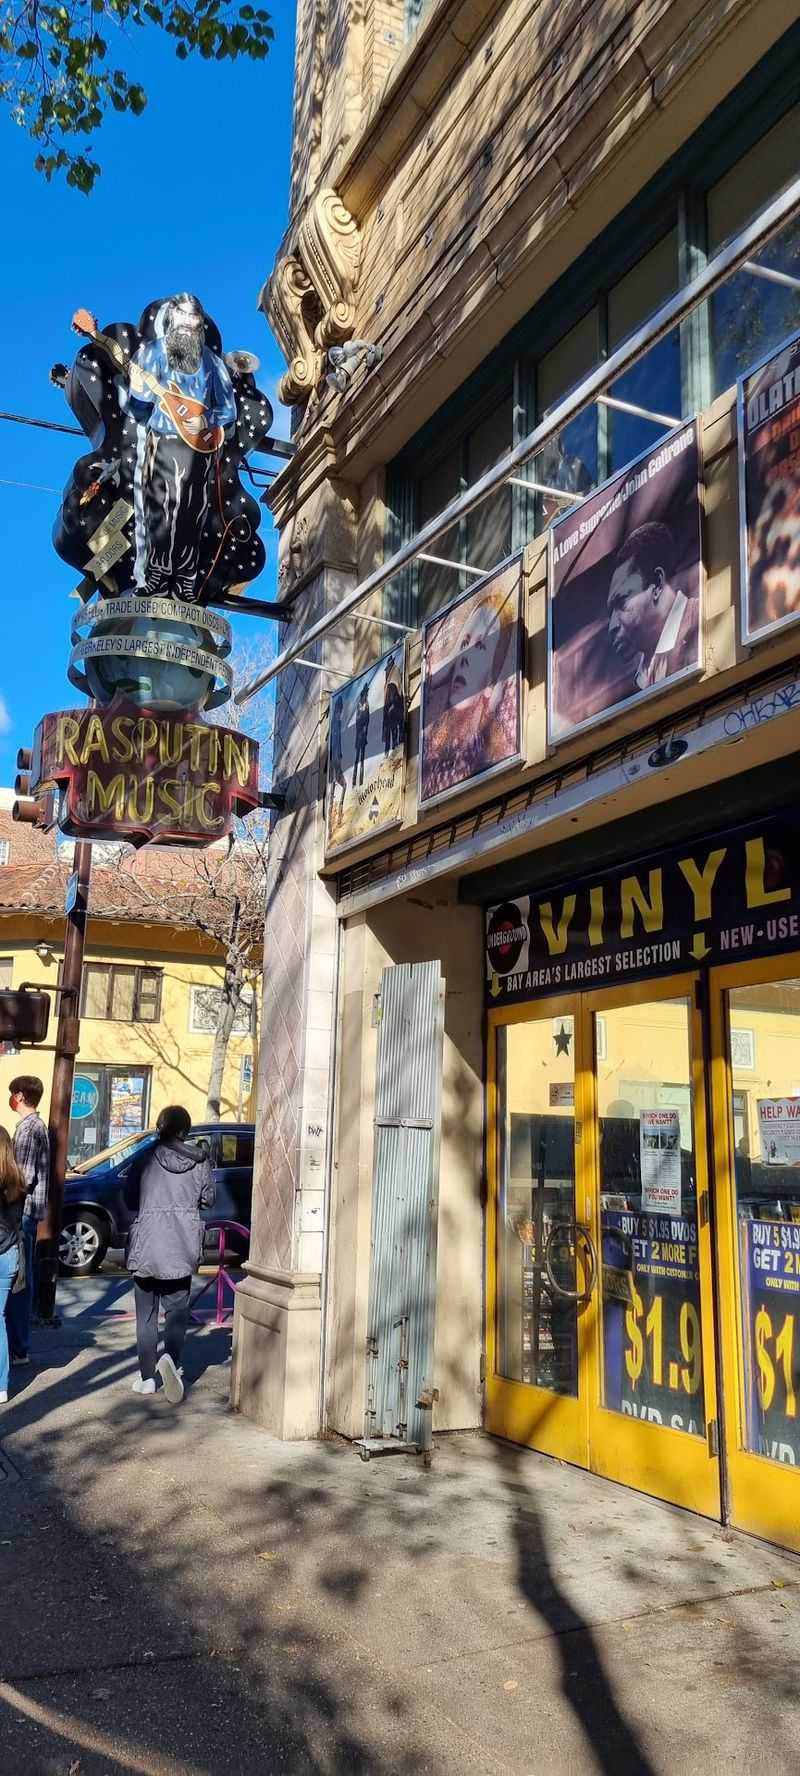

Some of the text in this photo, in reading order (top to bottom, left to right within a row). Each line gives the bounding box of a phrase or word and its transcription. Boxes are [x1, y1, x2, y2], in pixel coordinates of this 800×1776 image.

[553, 545, 560, 564] A
[560, 530, 579, 557] Love
[649, 428, 694, 478] Coltrane
[106, 601, 132, 615] TRADE
[134, 601, 158, 614] USED
[161, 602, 201, 621] COMPACT
[124, 640, 165, 655] LARGEST
[166, 643, 217, 671] INDEPENDENT
[55, 715, 250, 787] RASPUTIN
[85, 771, 225, 827] MUSIC
[538, 836, 792, 956] VINYL
[487, 925, 528, 949] UNDERGROUND
[720, 915, 800, 950] NEW USE
[507, 940, 681, 992] BAY AREA'S LARGEST SELECTION
[760, 1106, 782, 1120] HELP
[622, 1216, 697, 1242] BUY 5 $1.95 DVDS
[752, 1223, 771, 1246] BUY
[773, 1226, 780, 1248] 5
[651, 1241, 660, 1260] 2
[661, 1242, 686, 1264] MORE
[753, 1247, 781, 1271] GET
[784, 1251, 794, 1274] 2
[636, 1263, 650, 1274] ONLY
[651, 1264, 666, 1276] WITH
[765, 1276, 783, 1289] ONLY
